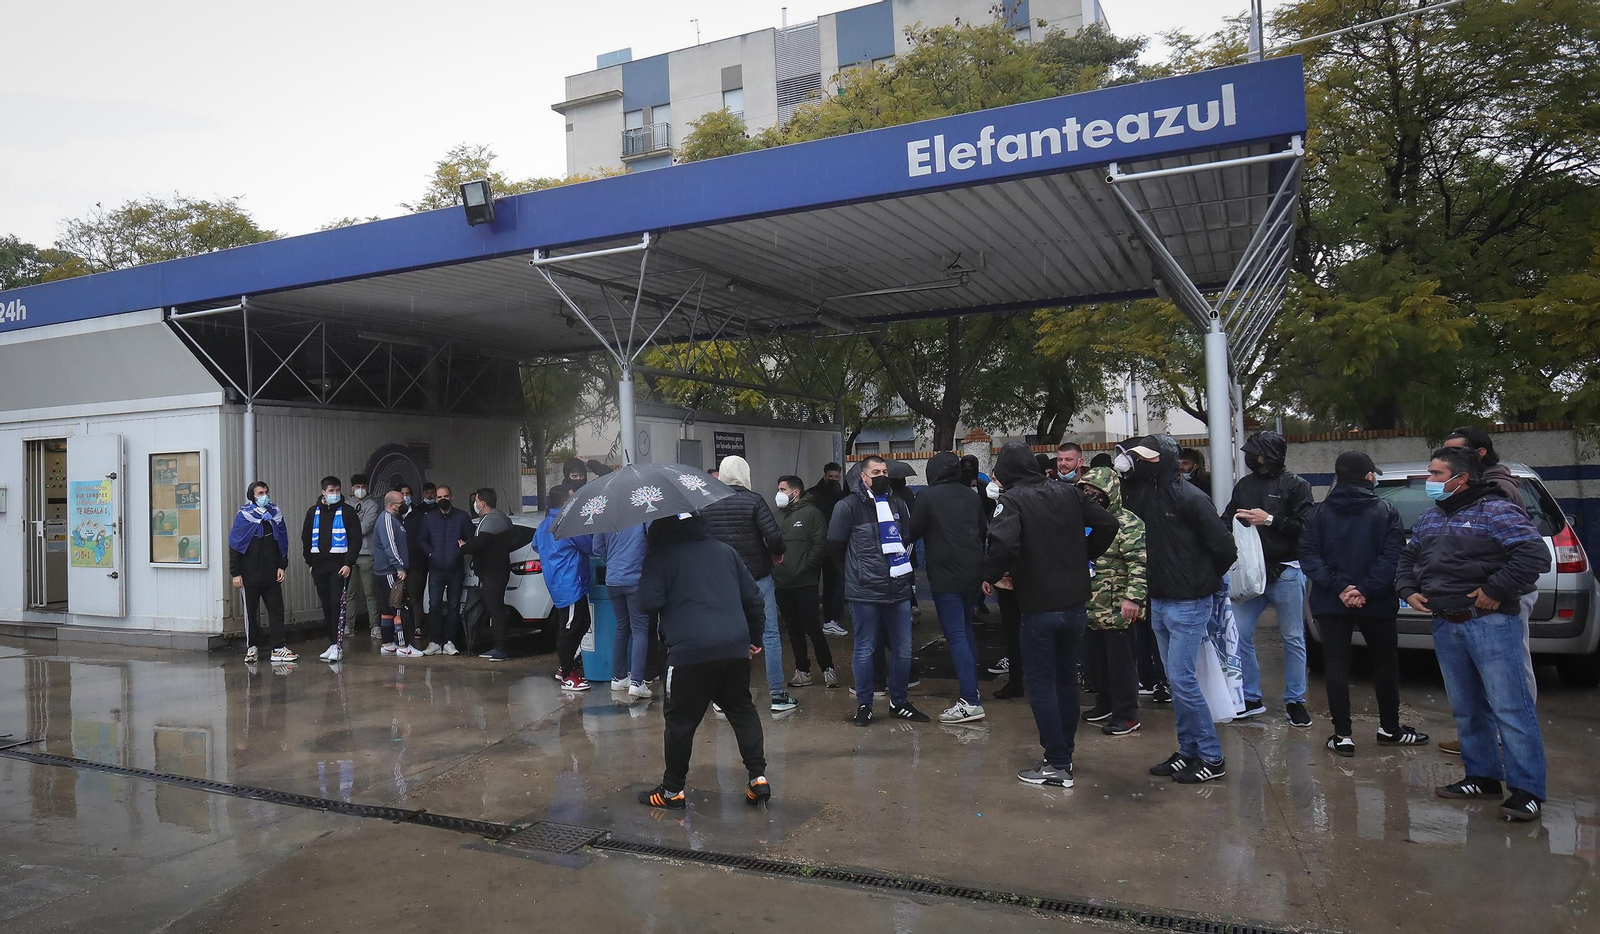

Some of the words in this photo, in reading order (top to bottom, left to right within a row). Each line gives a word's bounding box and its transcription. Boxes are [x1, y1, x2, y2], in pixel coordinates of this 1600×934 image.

[907, 83, 1237, 178] Elefanteazul
[0, 298, 27, 323] 24h
[84, 507, 103, 515] REGALA
